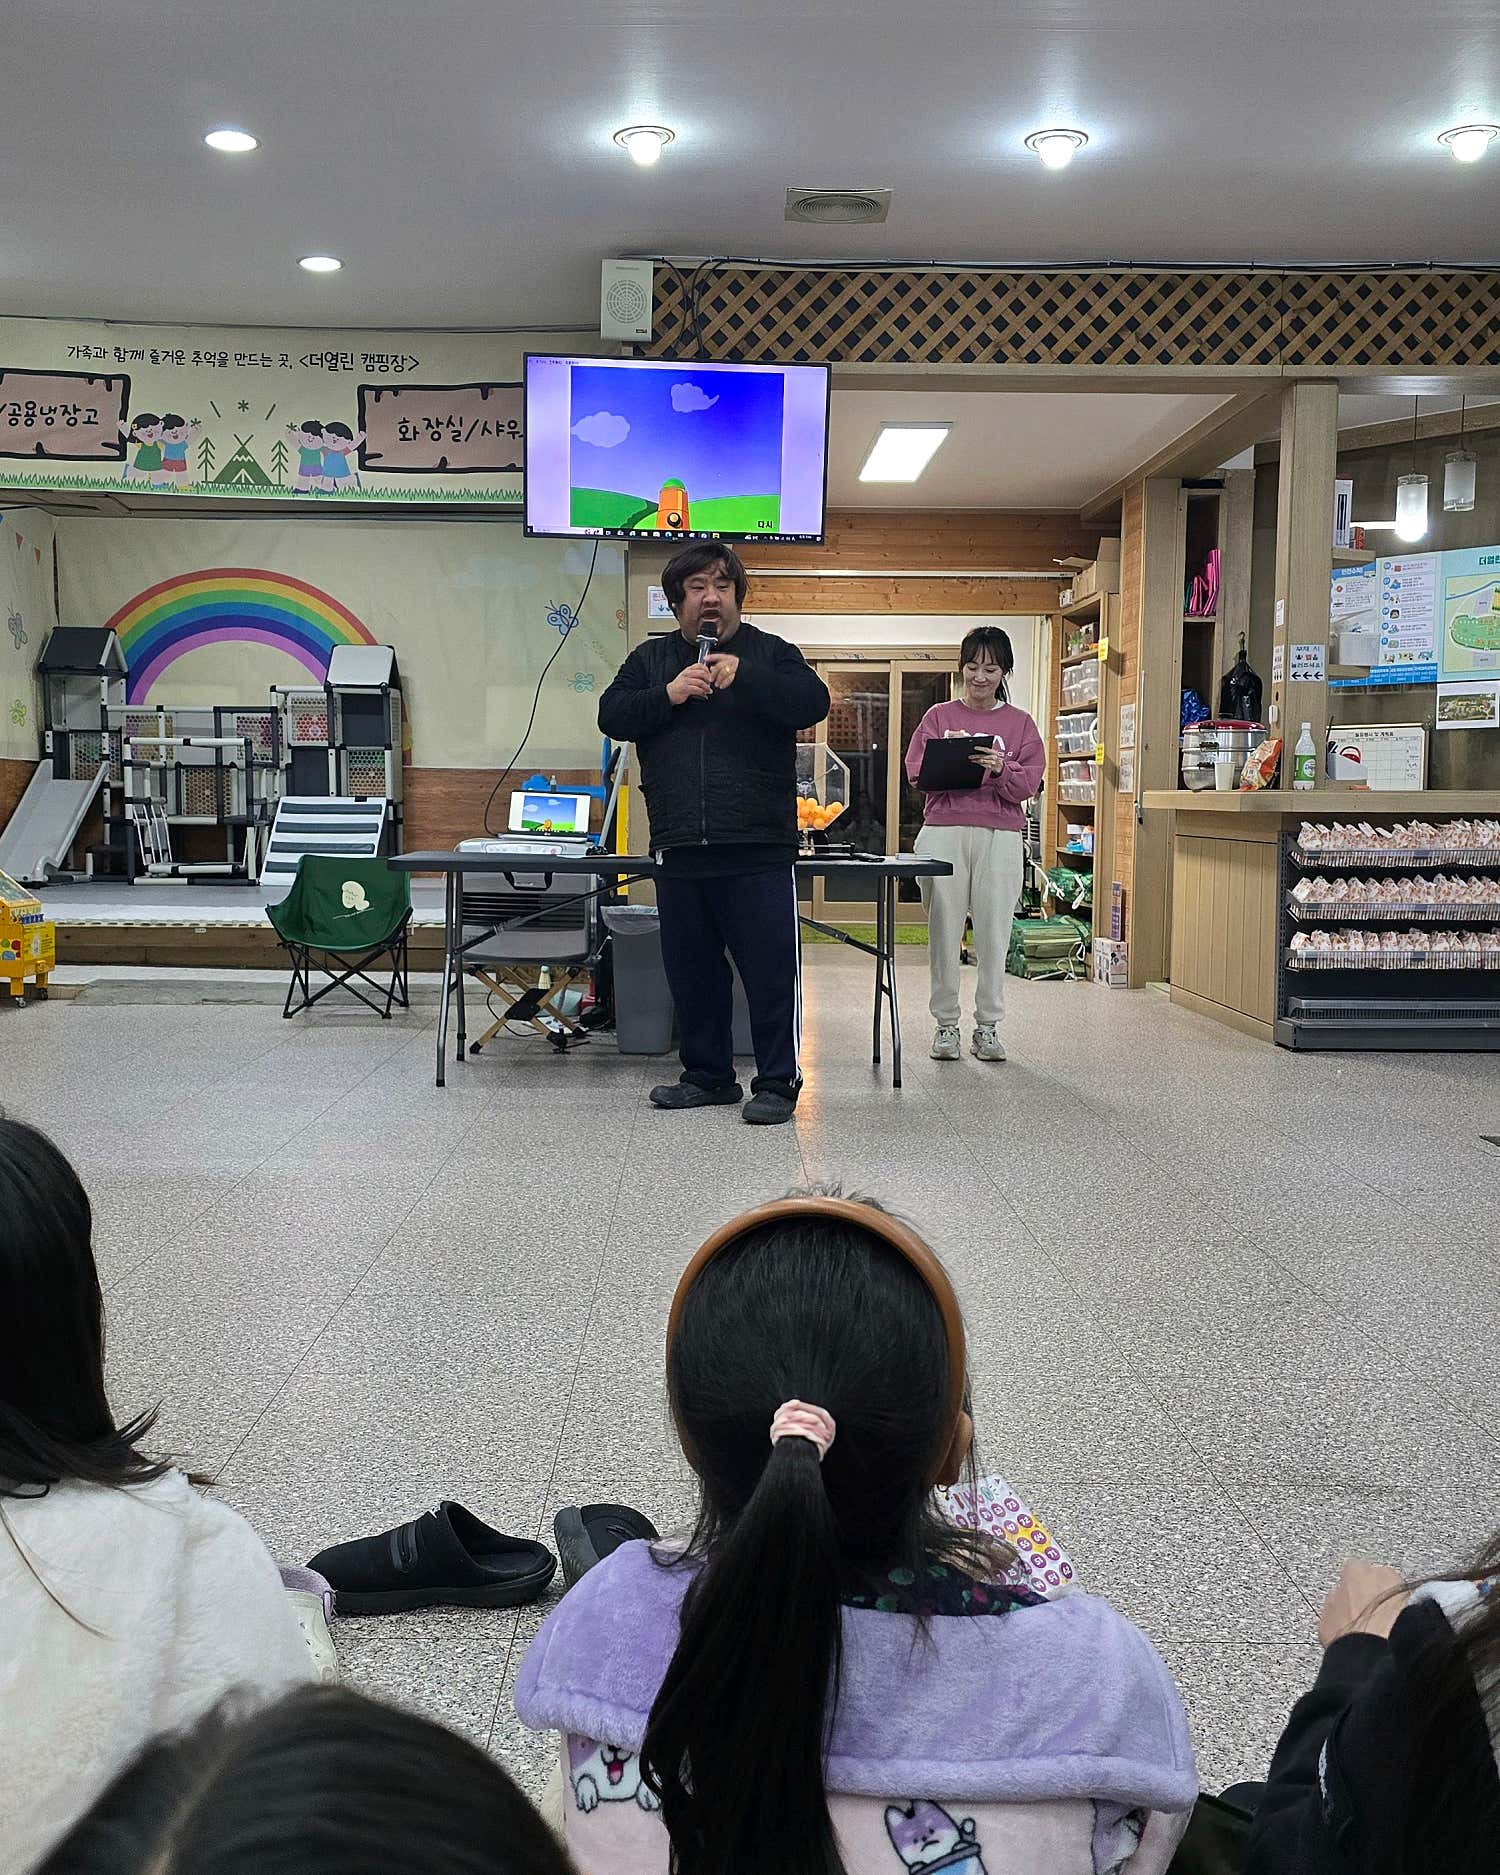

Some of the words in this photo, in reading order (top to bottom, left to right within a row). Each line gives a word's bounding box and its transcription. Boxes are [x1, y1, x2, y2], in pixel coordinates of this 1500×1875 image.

[67, 345, 109, 360] 가족과
[113, 346, 145, 363] 함께
[149, 348, 187, 366] 즐거운
[191, 350, 229, 368] 추억을
[234, 351, 273, 368] 만드는
[278, 353, 293, 369] 곳,
[299, 351, 354, 372] <더열린
[360, 352, 420, 373] 캠핑장>
[758, 520, 773, 530] 다시
[1019, 1517, 1030, 1526] 72
[1033, 1533, 1044, 1542] 64
